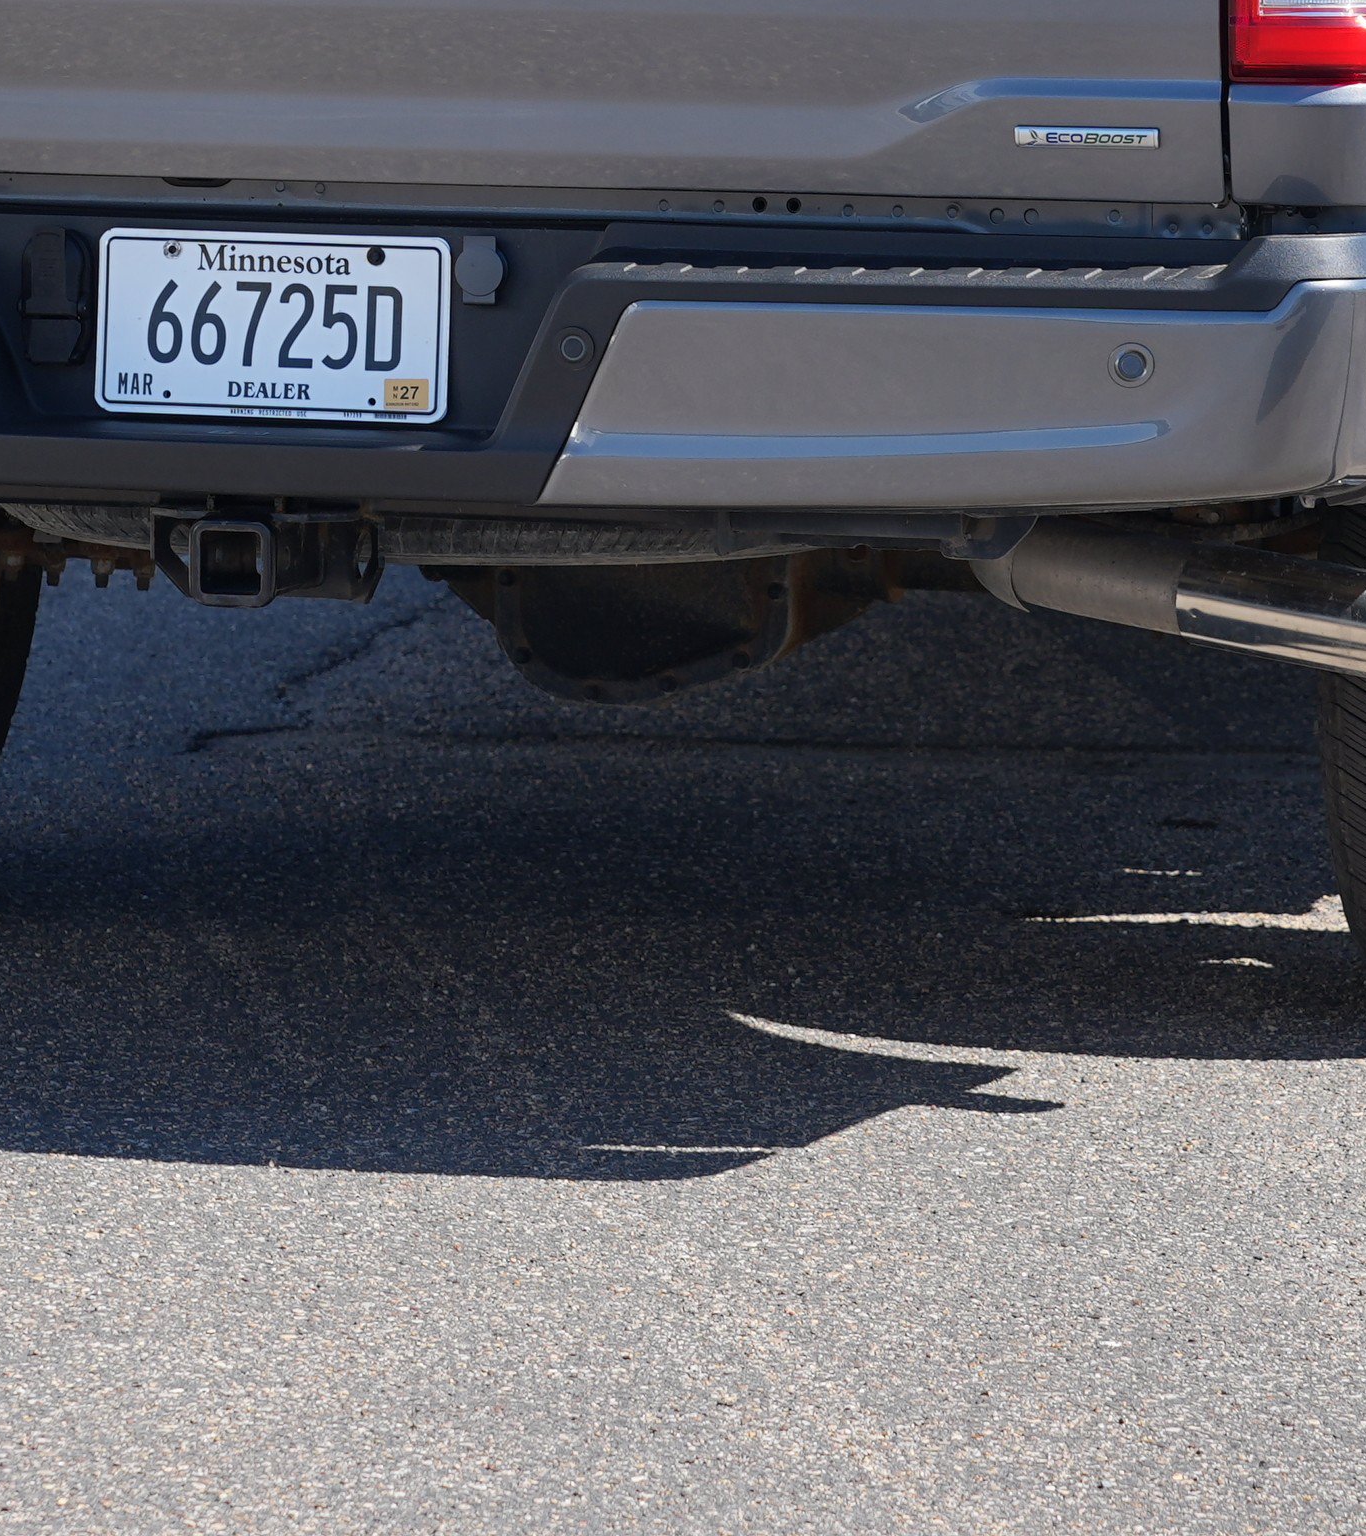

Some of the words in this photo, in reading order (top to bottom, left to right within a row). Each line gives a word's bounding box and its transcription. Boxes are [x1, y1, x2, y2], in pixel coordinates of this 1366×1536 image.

[197, 244, 351, 275] Minnesota
[146, 279, 403, 372] 66725D
[117, 372, 153, 396] MAR
[227, 381, 311, 401] DEALER
[400, 386, 419, 400] 27
